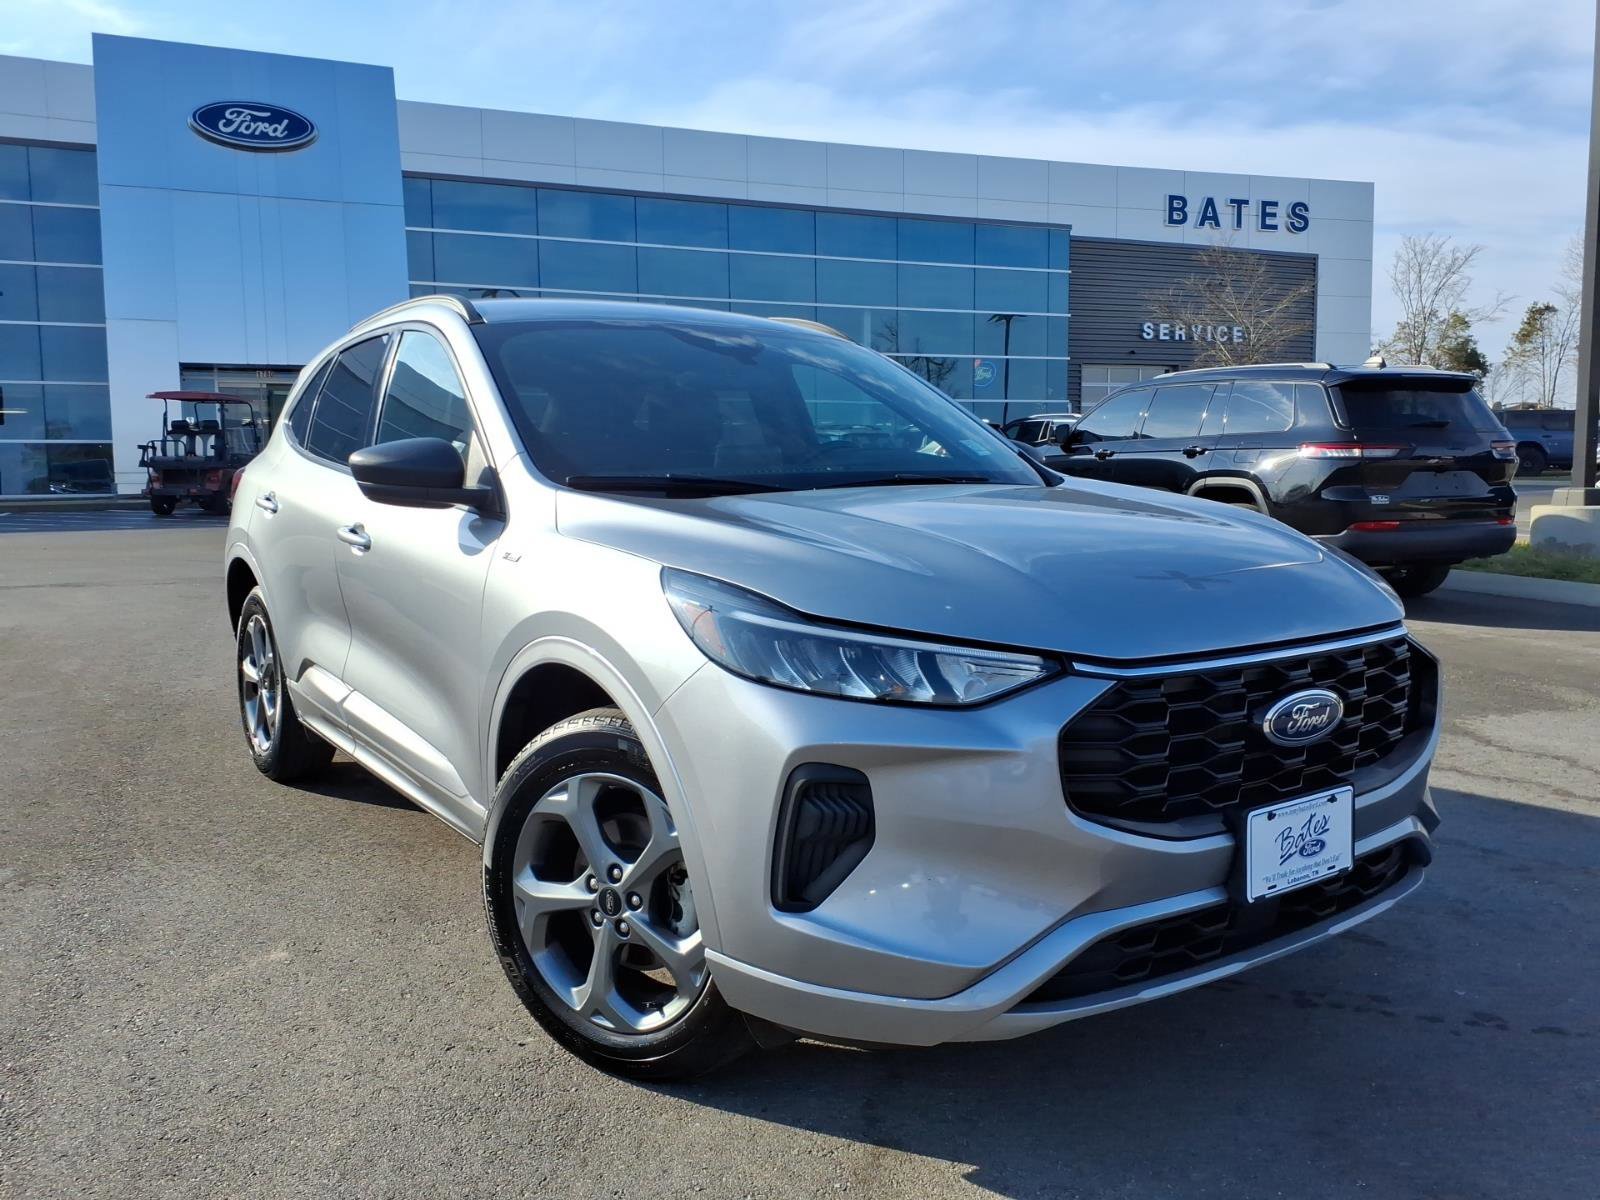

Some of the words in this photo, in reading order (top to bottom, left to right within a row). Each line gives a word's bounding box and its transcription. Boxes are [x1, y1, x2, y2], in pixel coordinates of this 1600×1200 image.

[218, 107, 289, 138] Ford
[1165, 194, 1310, 234] BATES
[1142, 321, 1244, 342] SERVICE
[1286, 702, 1331, 735] Ford
[1274, 812, 1331, 860] Bates
[1302, 841, 1322, 857] Ford
